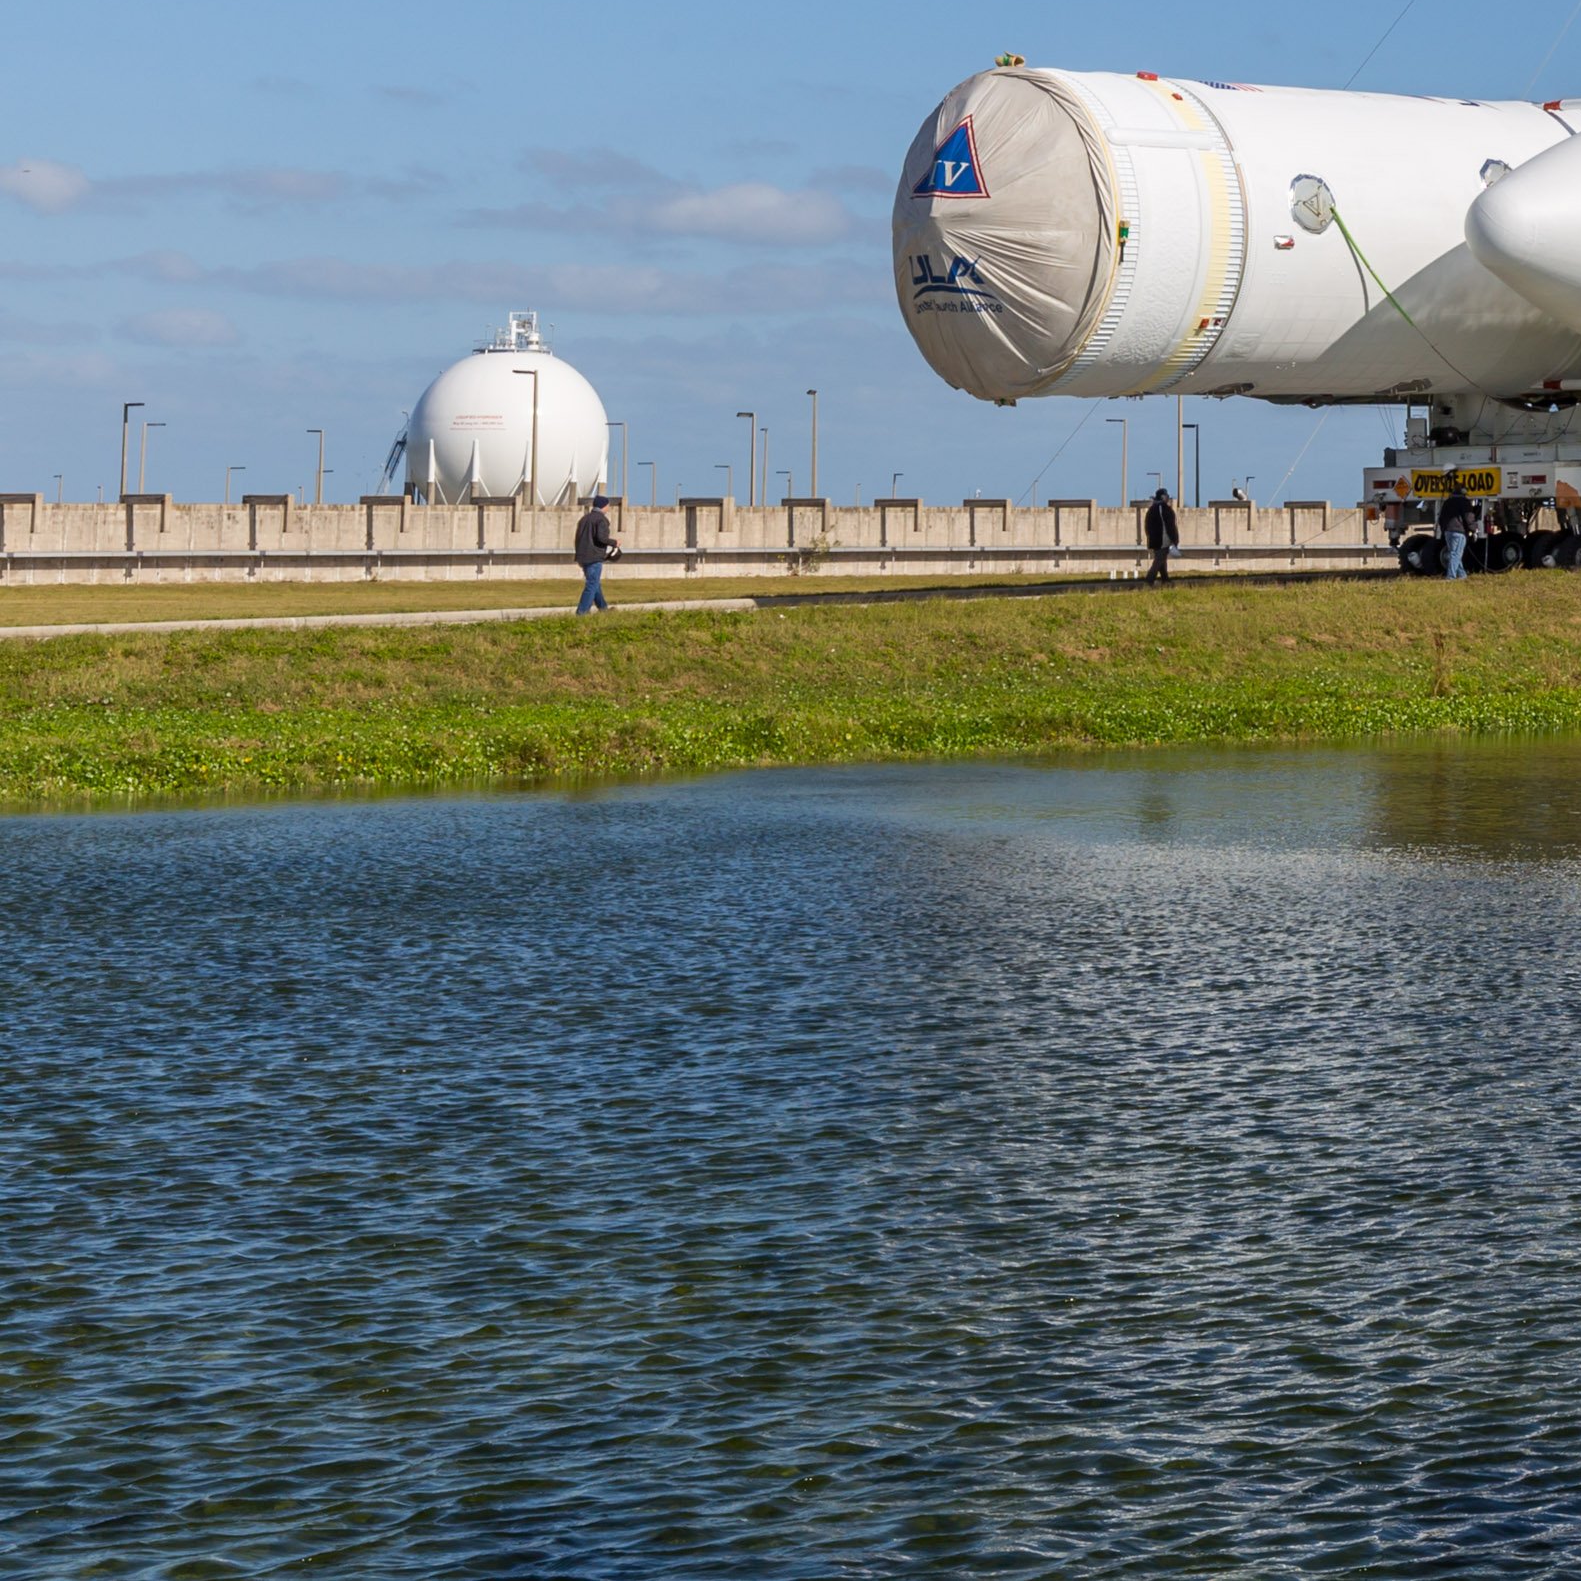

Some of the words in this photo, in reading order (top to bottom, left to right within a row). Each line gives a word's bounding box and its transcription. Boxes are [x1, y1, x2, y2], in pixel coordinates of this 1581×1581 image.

[928, 160, 970, 187] IV
[908, 255, 985, 284] ULA
[1460, 472, 1494, 491] LOAD
